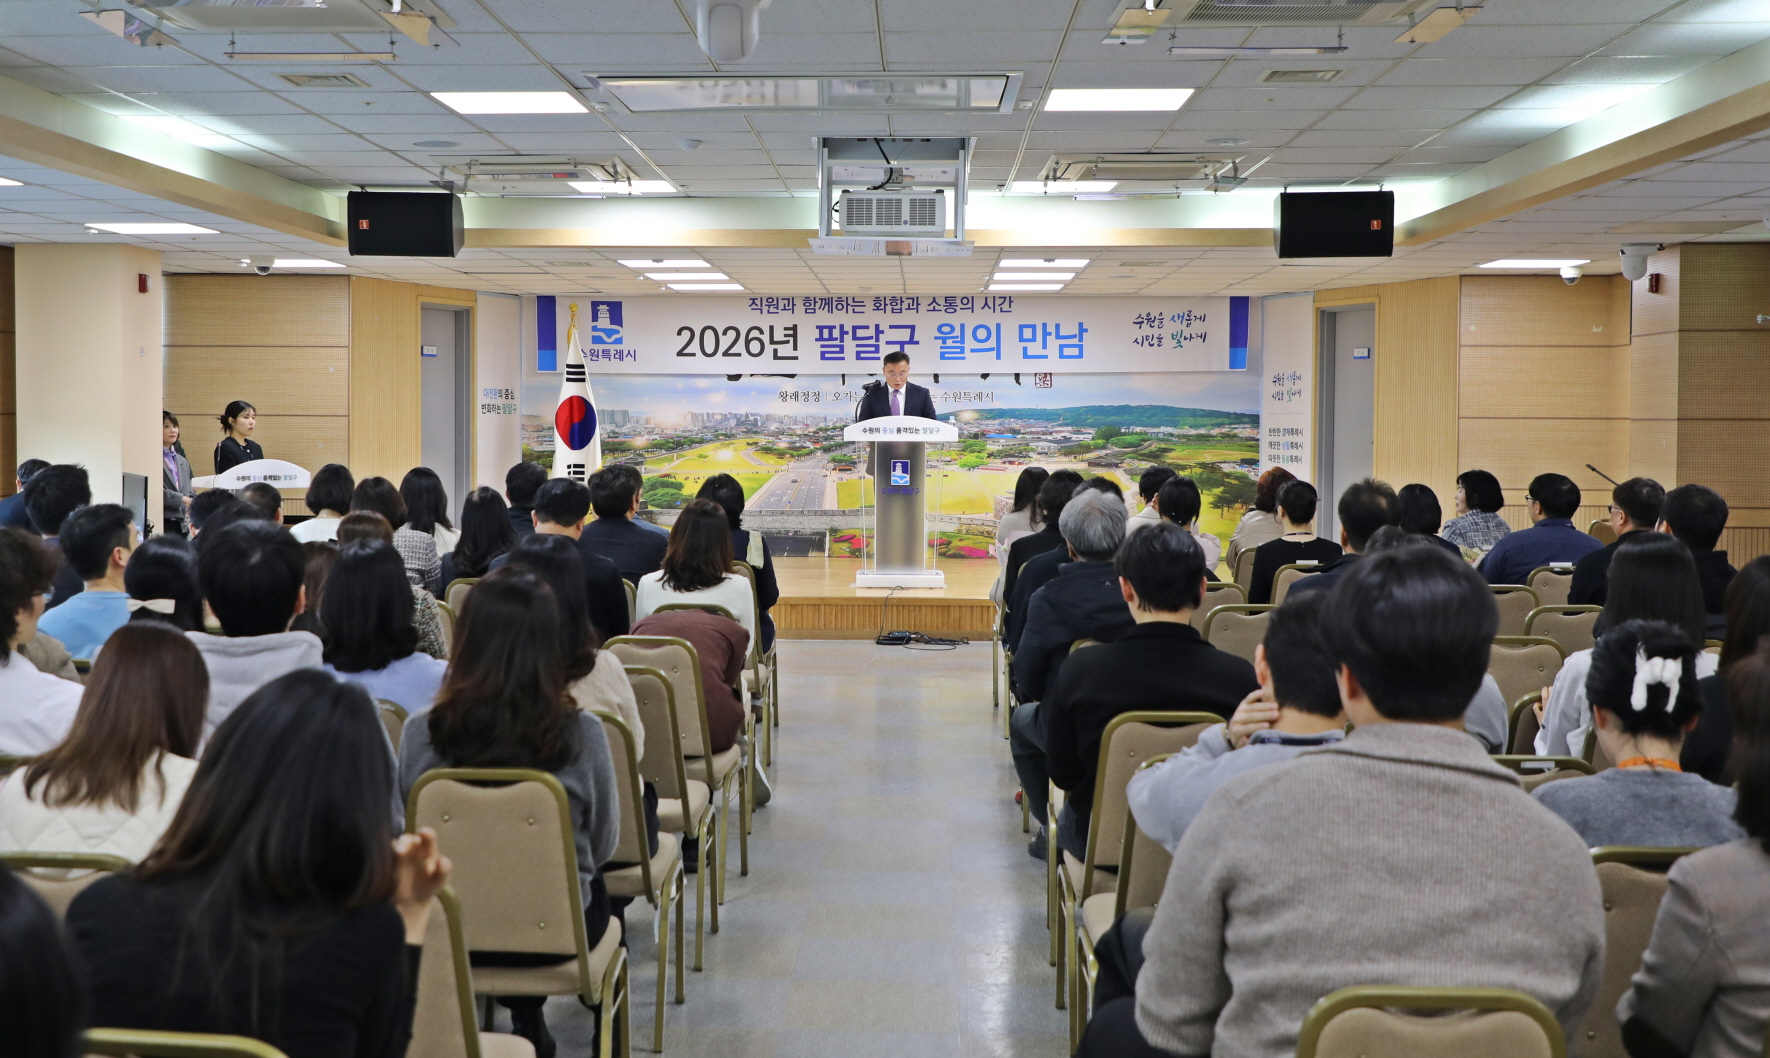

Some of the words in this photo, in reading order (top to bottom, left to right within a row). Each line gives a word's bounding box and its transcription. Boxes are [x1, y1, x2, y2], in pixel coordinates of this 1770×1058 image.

[748, 296, 797, 314] 직원과
[802, 296, 867, 314] 함께하는
[872, 296, 921, 314] 화합과
[926, 295, 975, 314] 소통의
[981, 295, 1014, 314] 시간
[1132, 311, 1165, 330] 수원을
[1168, 309, 1207, 328] 새롭게
[675, 323, 799, 361] 2026년
[814, 323, 920, 361] 팔달구
[933, 322, 1002, 361] 월의
[1018, 321, 1089, 360] 만남
[1132, 333, 1164, 348] 시민을
[1170, 329, 1207, 349] 빛나게
[504, 388, 516, 400] 중심
[778, 390, 821, 403] 왕래정정
[940, 390, 994, 403] 수원특례시
[502, 403, 517, 415] 팔달구
[862, 426, 881, 435] 수원의
[882, 426, 895, 435] 중심
[922, 426, 941, 435] 팔달구
